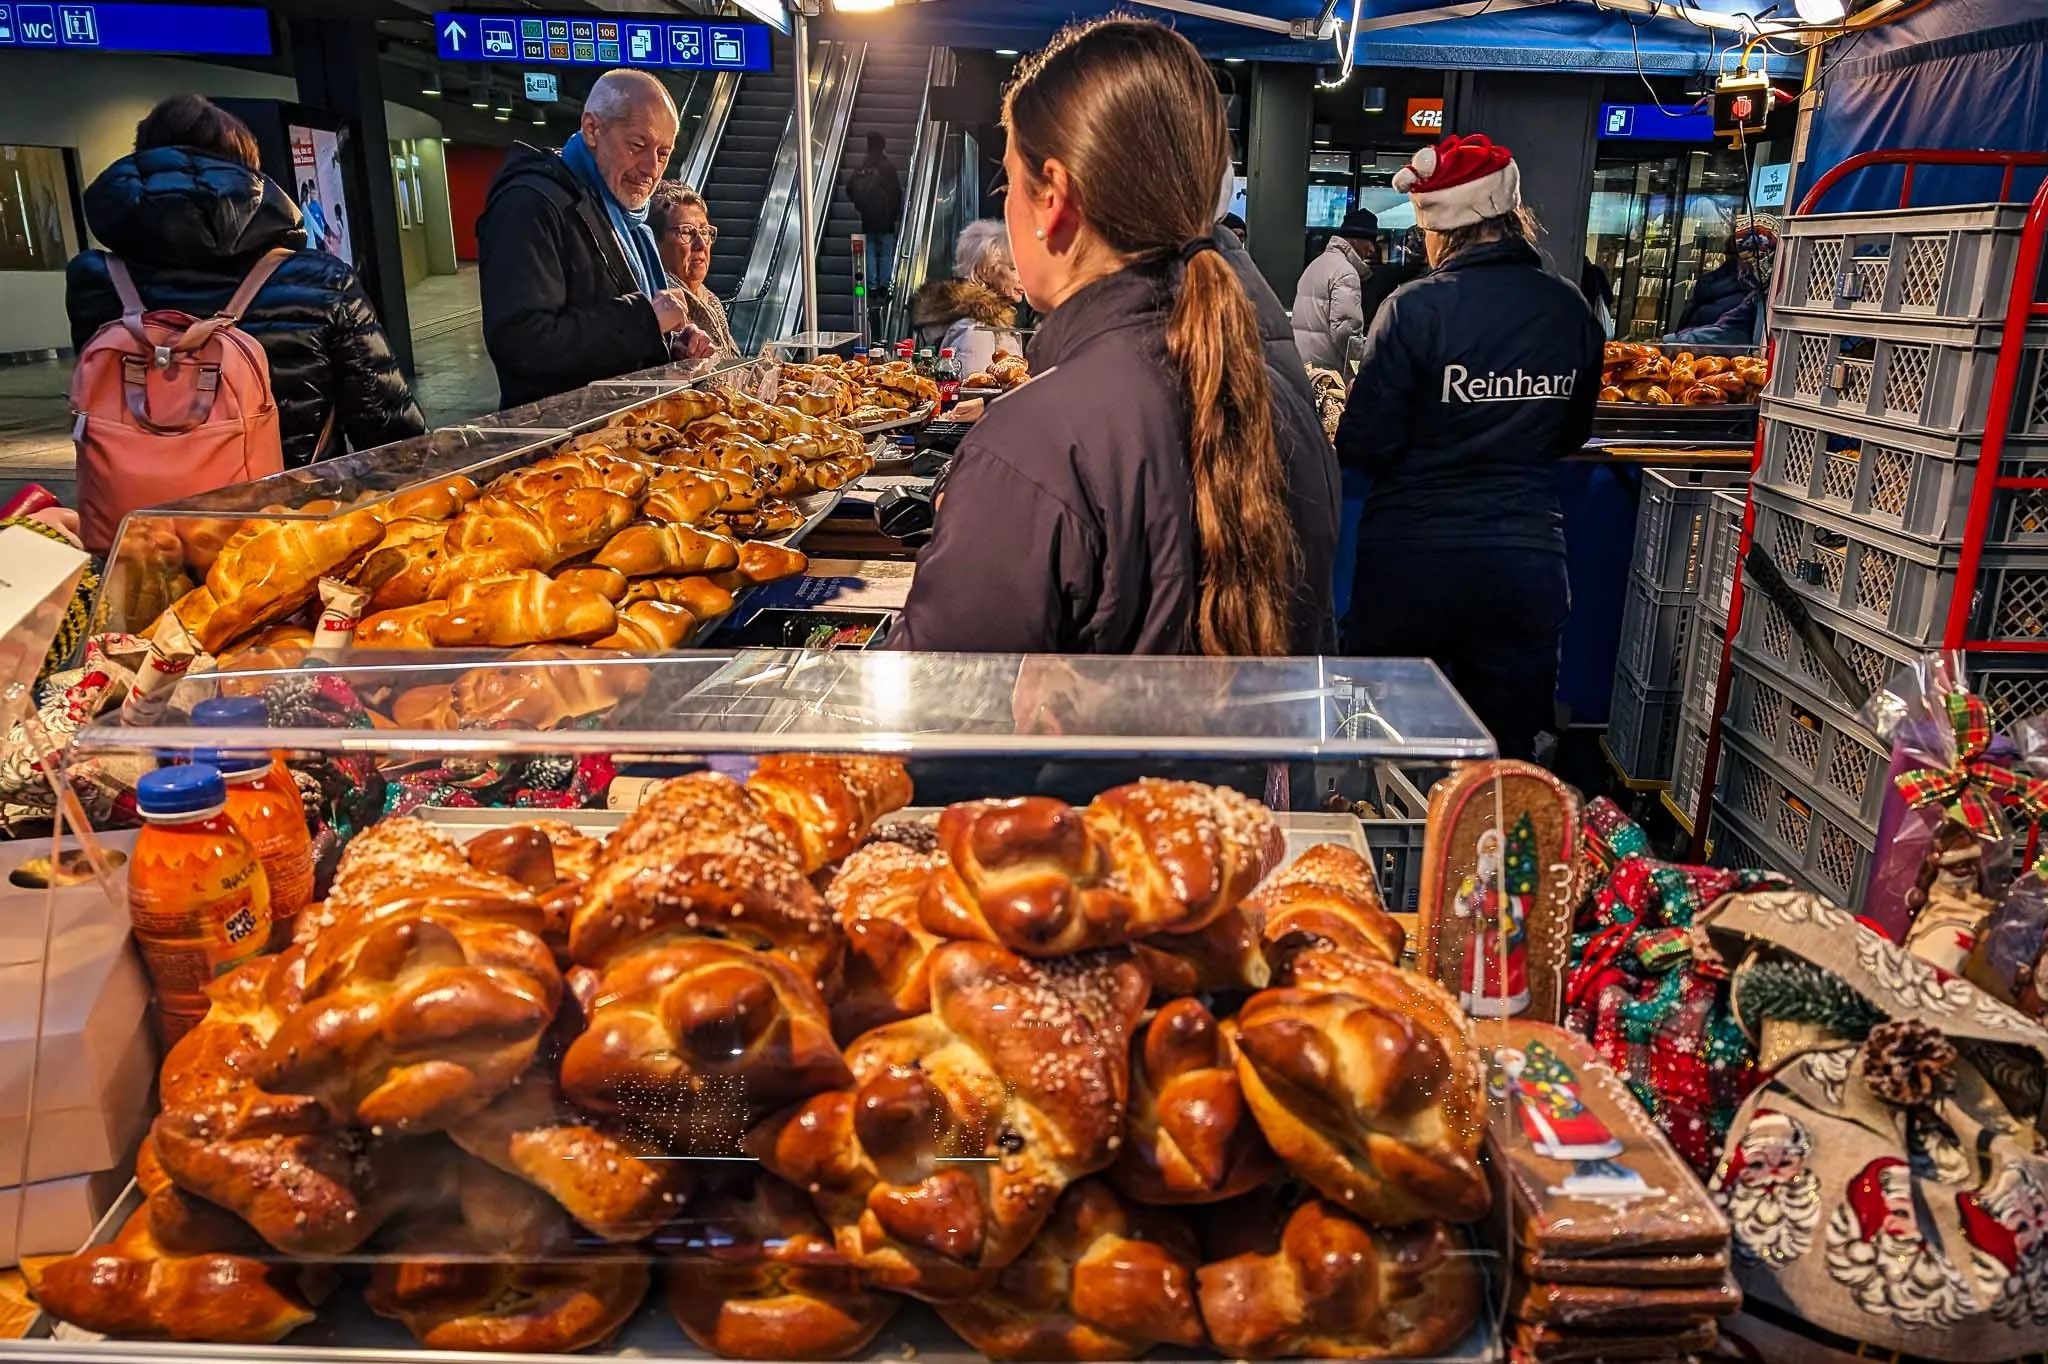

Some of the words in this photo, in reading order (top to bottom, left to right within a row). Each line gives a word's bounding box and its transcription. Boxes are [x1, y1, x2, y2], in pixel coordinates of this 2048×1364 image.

[23, 23, 53, 39] WC
[550, 26, 565, 35] 102
[575, 27, 590, 36] 104
[600, 28, 616, 37] 106
[526, 46, 541, 55] 101
[552, 47, 567, 56] 103
[576, 48, 592, 56] 105
[602, 49, 617, 57] 107
[1440, 364, 1577, 403] Reinhard
